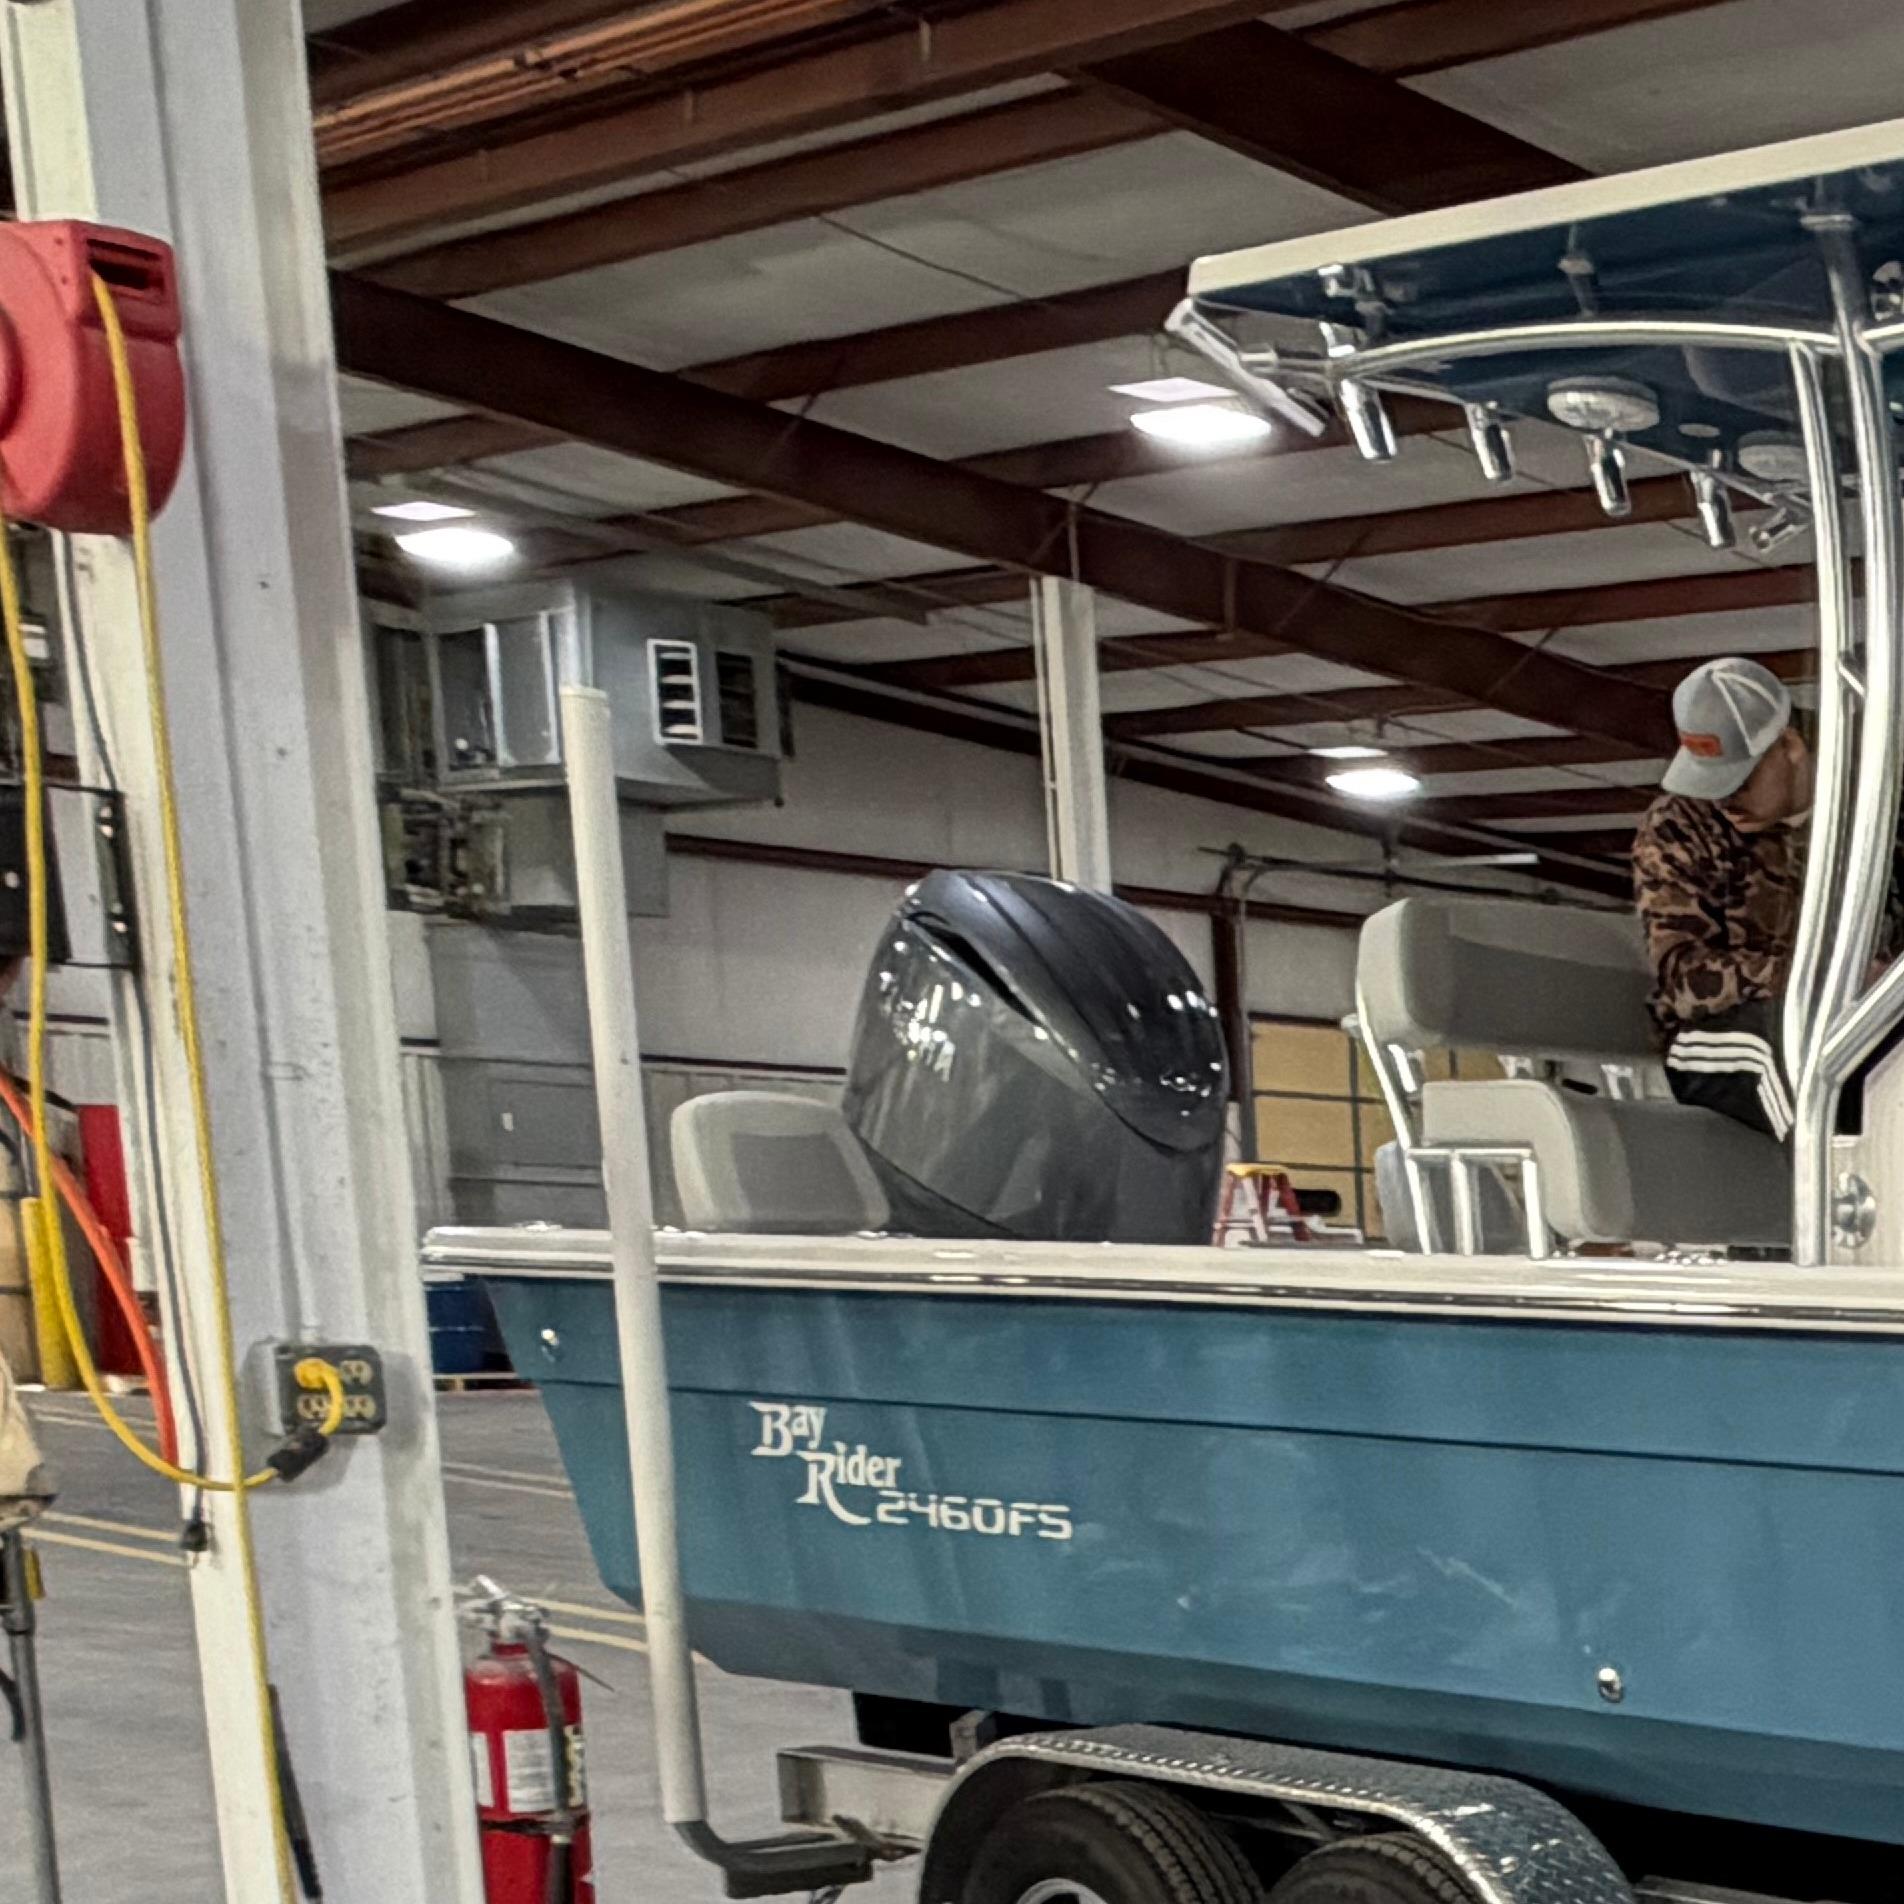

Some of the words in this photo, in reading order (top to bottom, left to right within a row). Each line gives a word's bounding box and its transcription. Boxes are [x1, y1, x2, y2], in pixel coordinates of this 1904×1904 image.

[748, 1401, 828, 1457] Bay
[795, 1441, 902, 1526] Rider
[876, 1491, 1074, 1540] 2460FS
